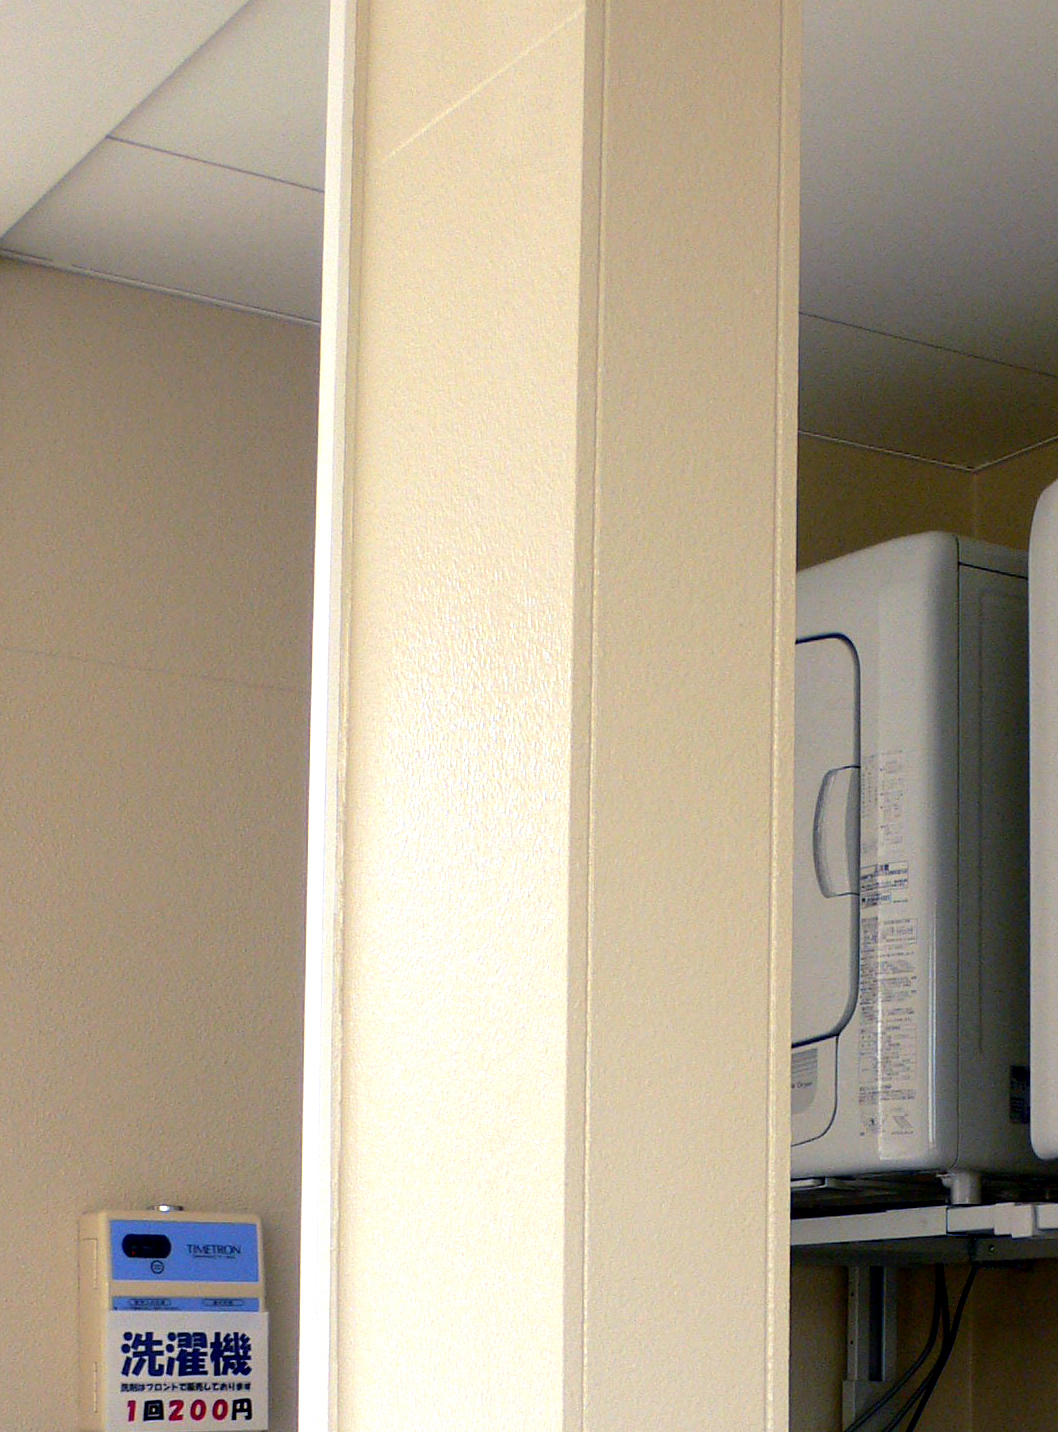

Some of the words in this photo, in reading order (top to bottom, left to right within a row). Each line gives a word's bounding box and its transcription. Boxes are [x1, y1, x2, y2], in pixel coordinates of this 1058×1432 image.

[187, 1243, 242, 1255] TIMETRON
[121, 1331, 252, 1376] 洗濯機
[127, 1397, 253, 1422] 1回200円
